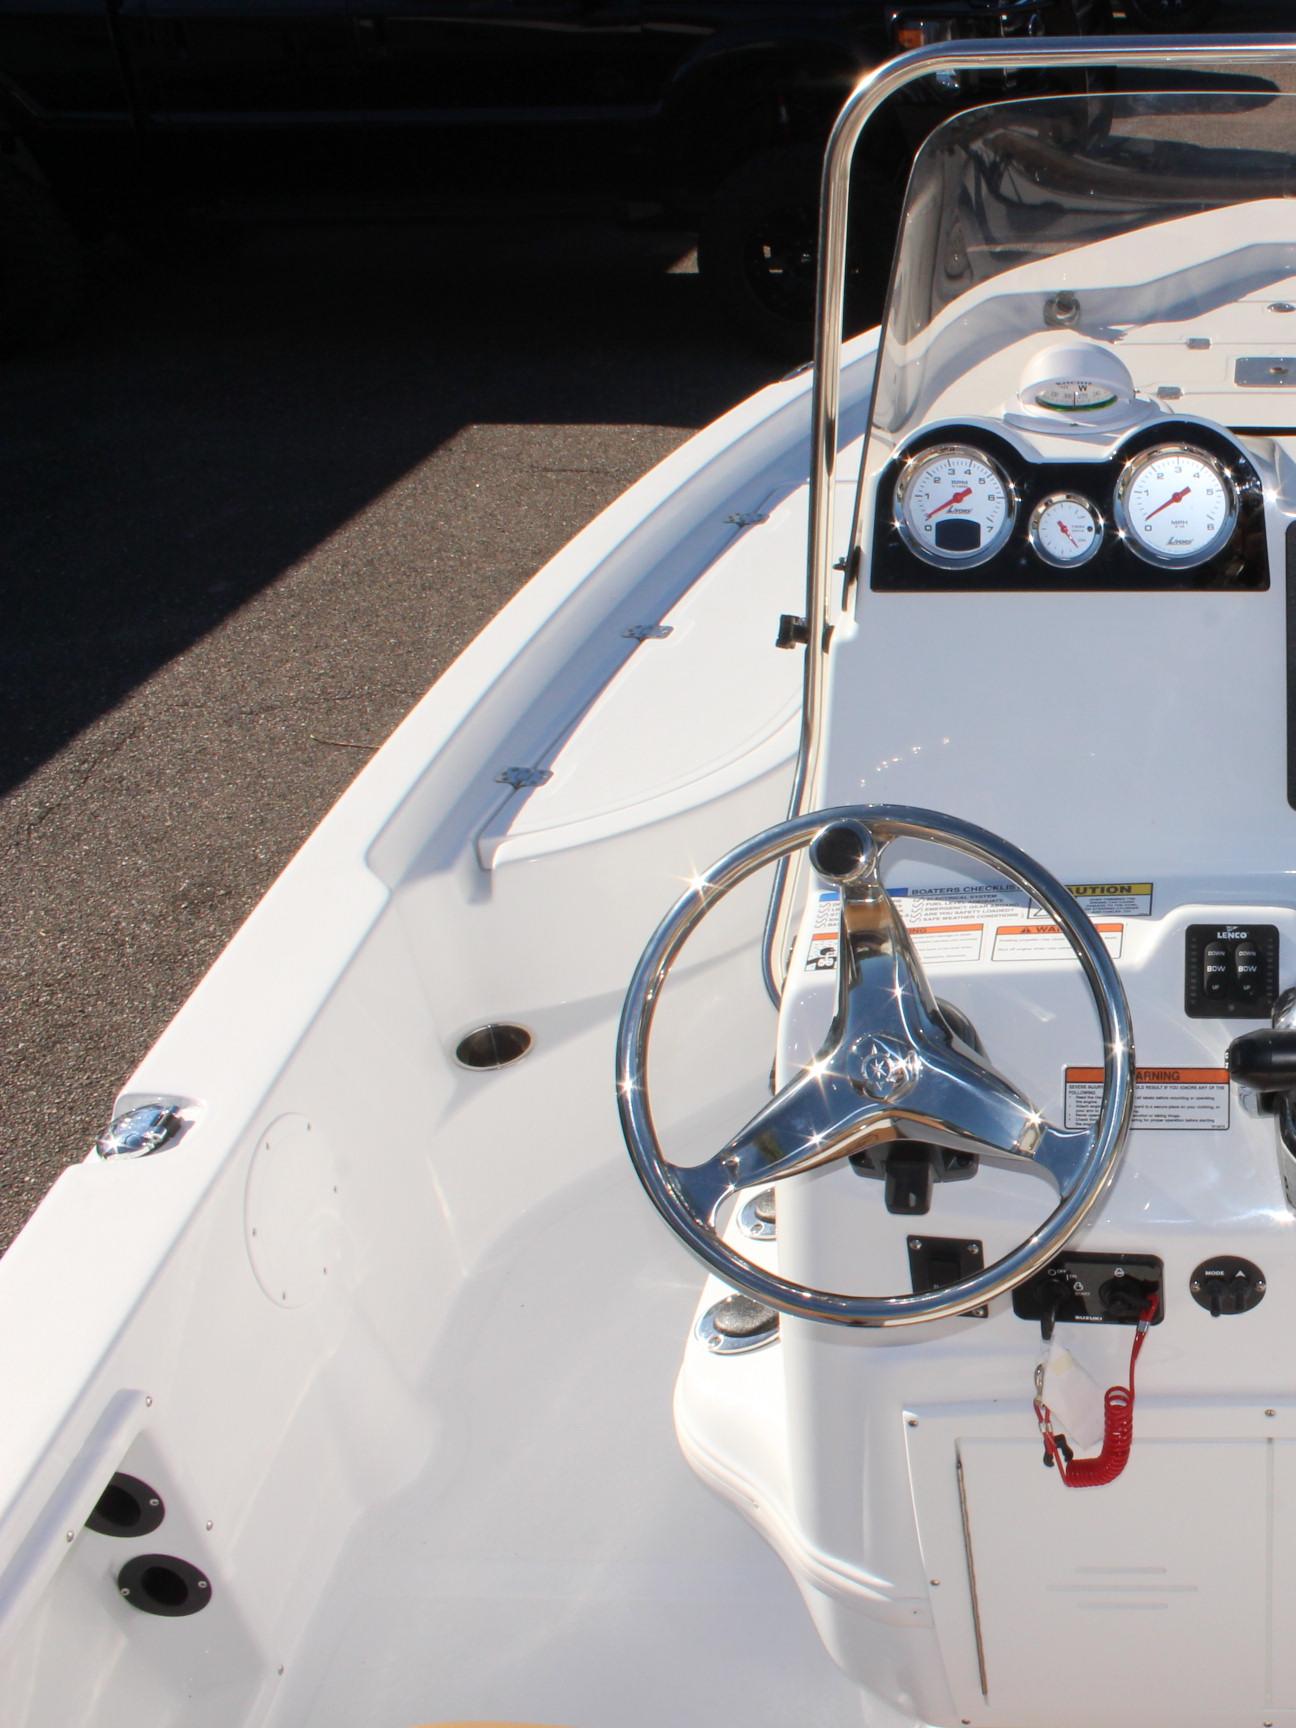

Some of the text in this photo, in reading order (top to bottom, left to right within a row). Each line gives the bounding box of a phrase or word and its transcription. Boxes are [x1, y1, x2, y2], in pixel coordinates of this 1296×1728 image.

[933, 476, 941, 484] 2
[911, 884, 1021, 895] BOATERS CHECKLIS
[1217, 931, 1248, 939] LENCO
[1136, 1071, 1180, 1081] ARNING
